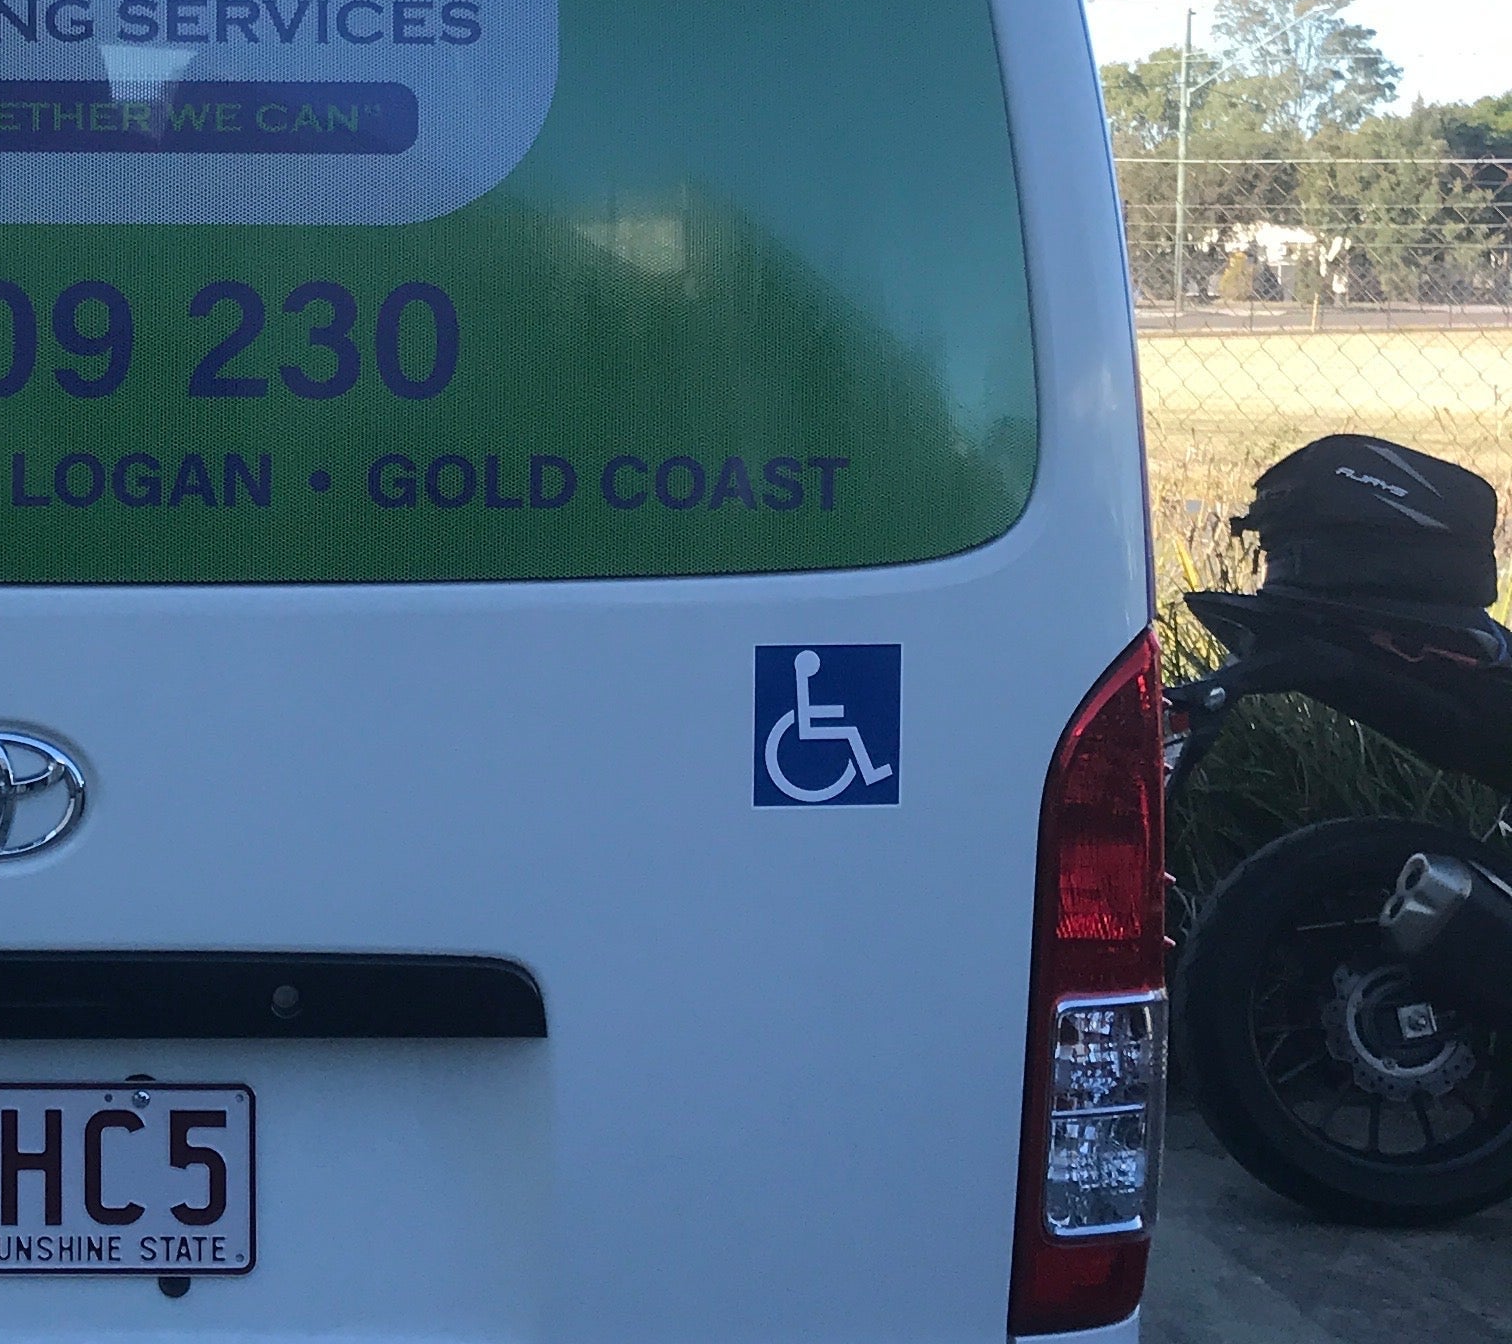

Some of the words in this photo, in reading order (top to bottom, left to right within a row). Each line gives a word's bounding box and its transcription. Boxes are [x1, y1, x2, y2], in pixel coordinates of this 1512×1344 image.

[166, 102, 244, 132] WE
[188, 279, 461, 401] 230
[11, 452, 273, 510] LOGAN
[366, 454, 579, 511] GOLD
[600, 455, 851, 513] COAST
[139, 1235, 227, 1262] STATE
